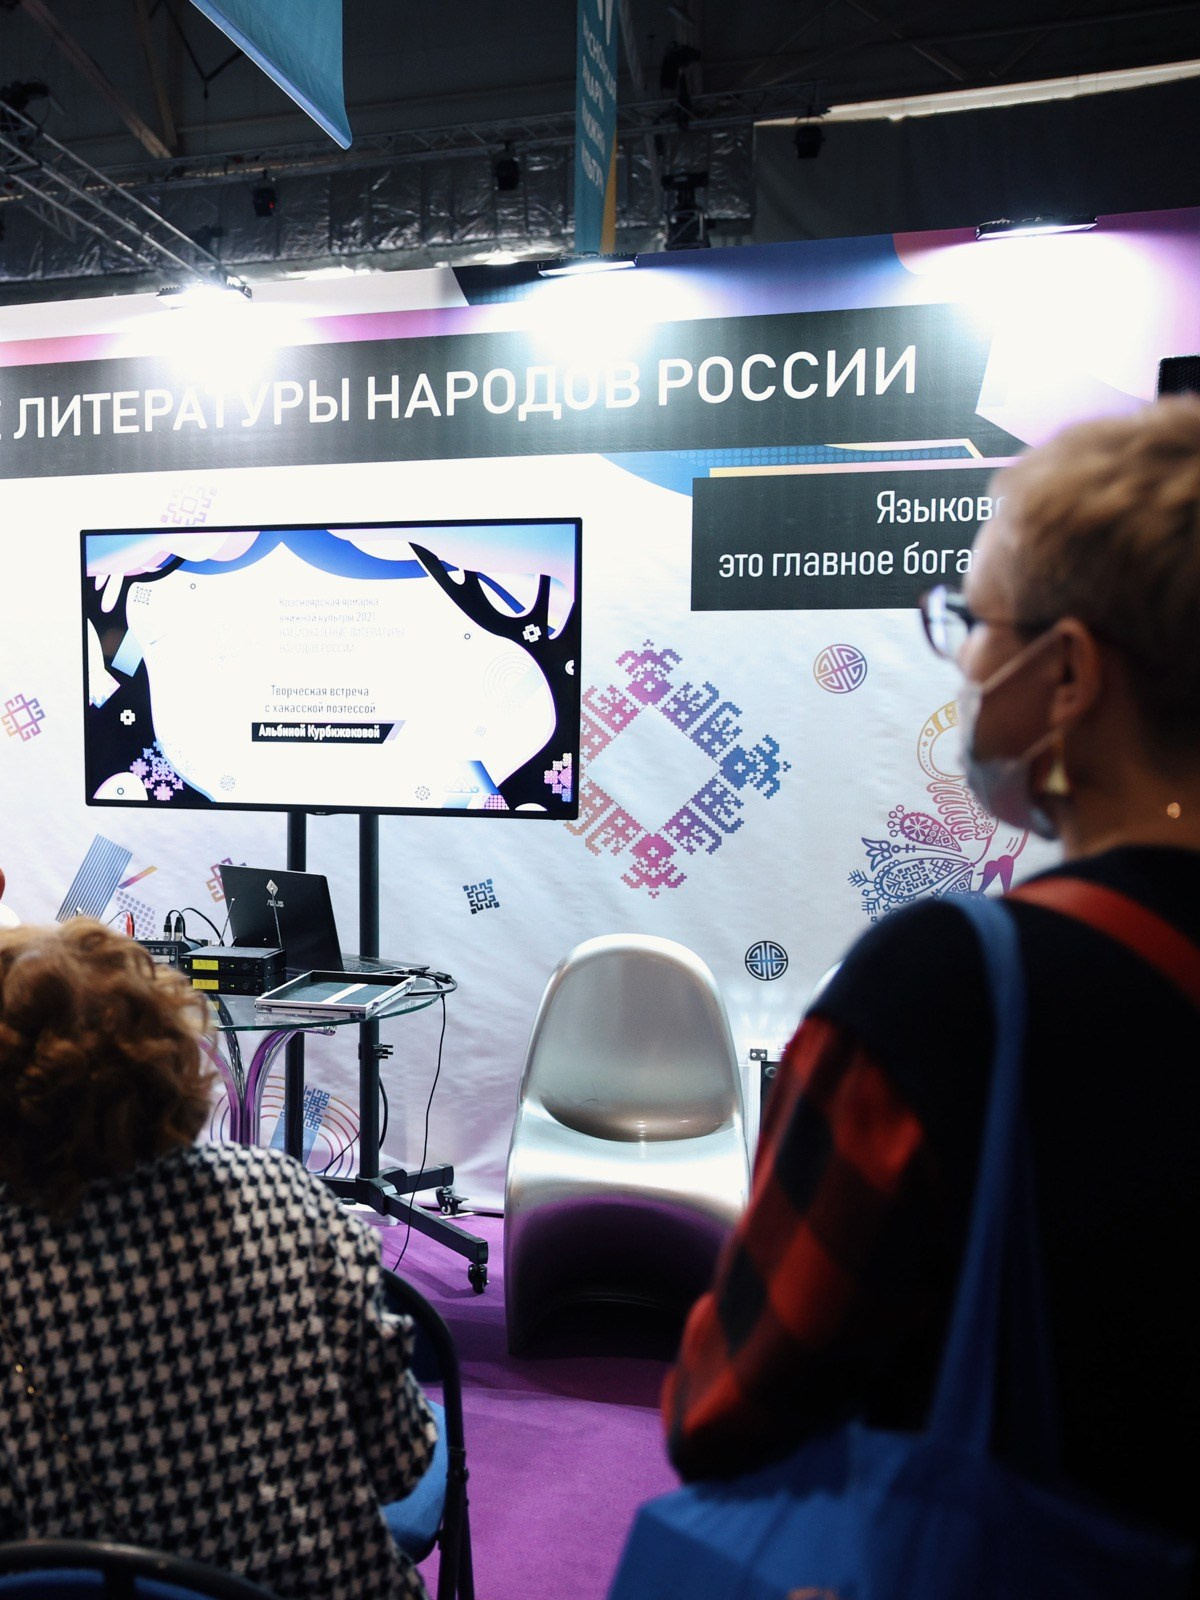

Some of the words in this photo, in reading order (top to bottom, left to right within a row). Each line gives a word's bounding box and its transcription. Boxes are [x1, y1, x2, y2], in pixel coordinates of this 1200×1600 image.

[13, 377, 350, 440] ЛИТЕРАТУРЫ
[367, 361, 641, 422] НАРОДОВ
[658, 344, 916, 406] РОССИИ
[718, 553, 764, 578] это
[772, 550, 894, 577] главное
[903, 541, 980, 575] бога
[271, 684, 327, 698] Творческая
[330, 687, 369, 698] встреча
[264, 704, 270, 713] с
[273, 702, 324, 713] хакасской
[326, 702, 376, 714] поэтессой
[258, 723, 306, 738] Альбиной
